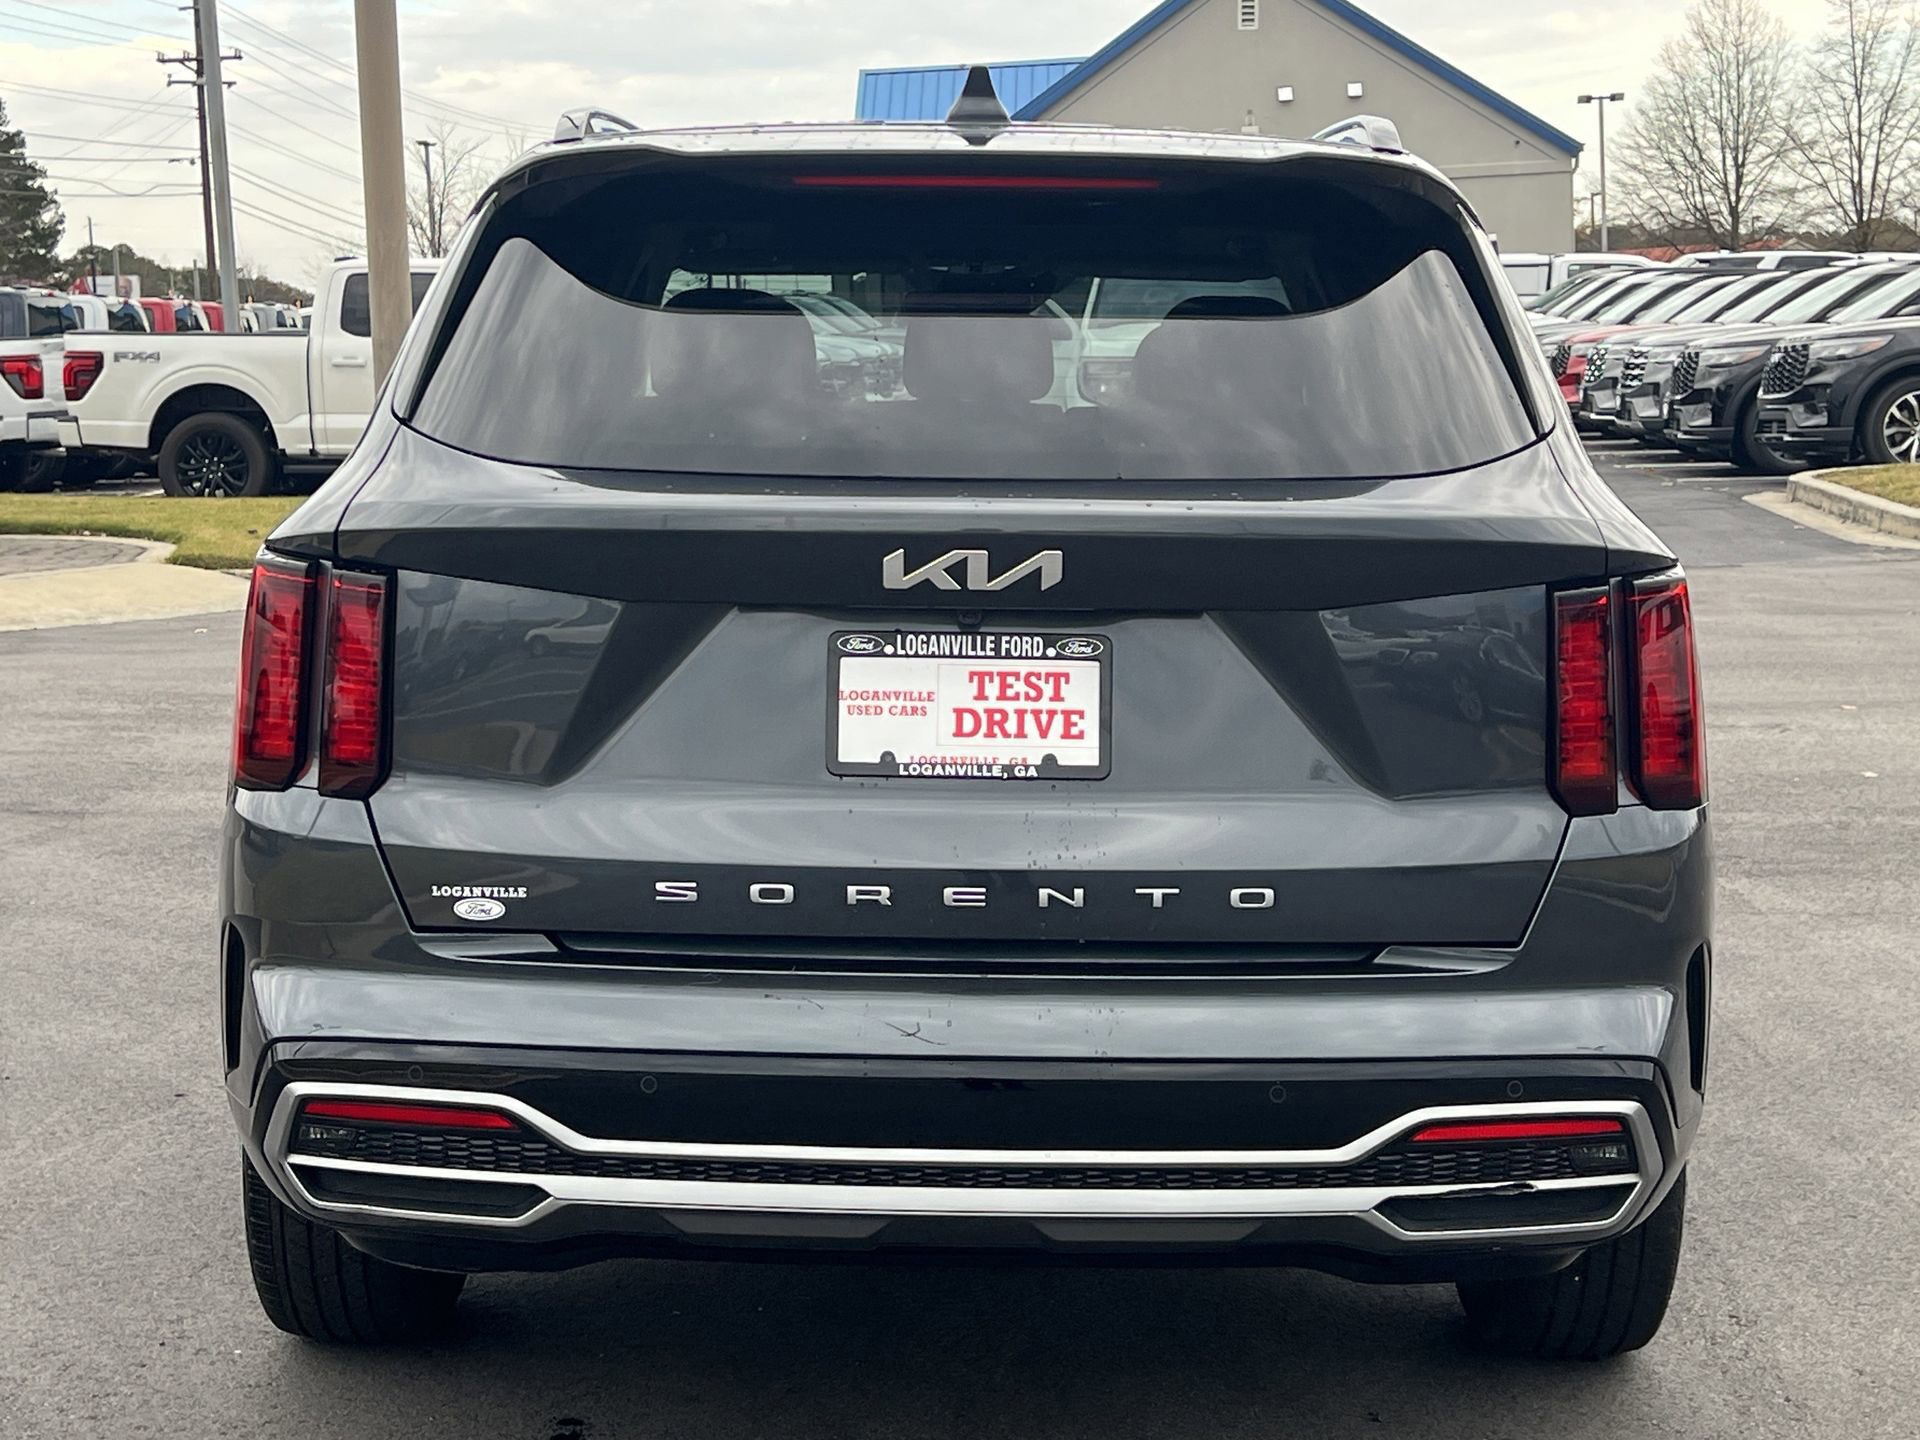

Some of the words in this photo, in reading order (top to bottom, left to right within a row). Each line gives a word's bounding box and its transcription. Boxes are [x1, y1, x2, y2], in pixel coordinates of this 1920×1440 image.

[114, 352, 160, 362] FX4
[847, 638, 875, 650] Ford
[896, 634, 995, 656] LOGANVILLE
[1001, 636, 1043, 657] FORD
[1065, 640, 1094, 654] Ford
[969, 671, 1070, 702] TEST
[839, 690, 935, 703] LOGANVILLE
[847, 705, 883, 716] USED
[889, 705, 927, 717] CARS
[952, 708, 1085, 740] DRIVE
[899, 764, 1008, 779] LOGANVILLE,
[1014, 766, 1038, 777] GA
[431, 885, 527, 898] LOGANVILLE
[654, 880, 1276, 909] SORENTO
[465, 902, 493, 916] Ford
